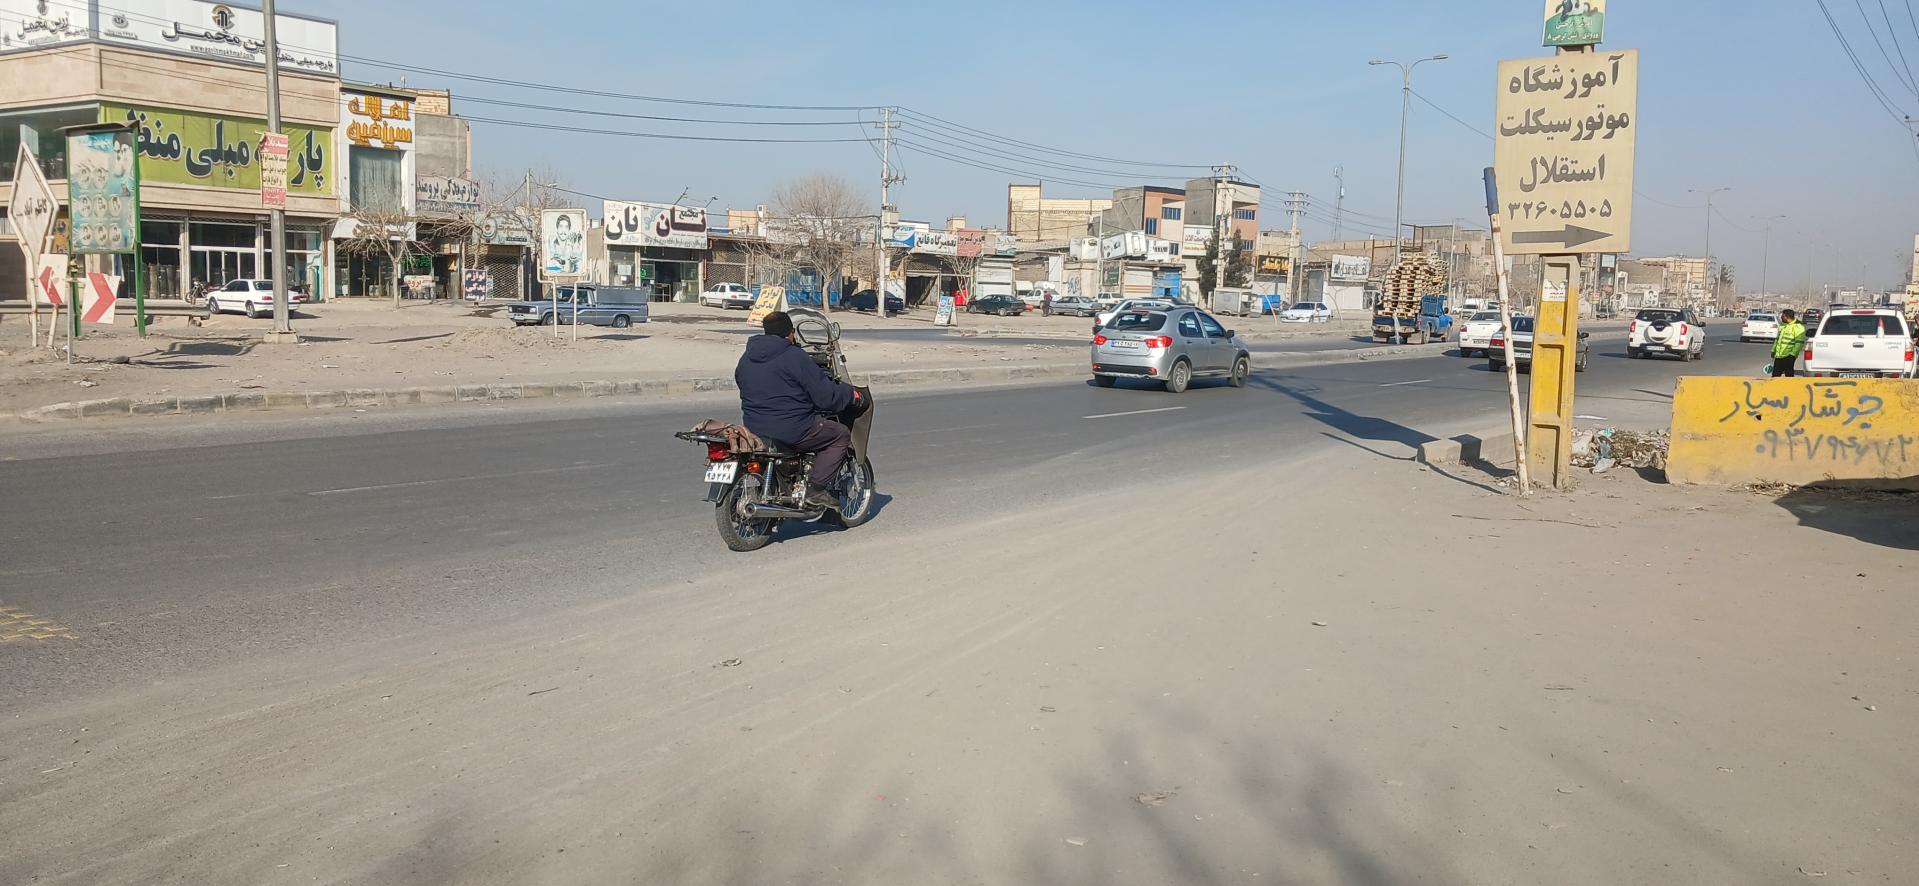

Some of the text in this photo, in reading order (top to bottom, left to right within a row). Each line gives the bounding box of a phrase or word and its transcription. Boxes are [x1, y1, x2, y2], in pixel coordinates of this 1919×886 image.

[1509, 54, 1625, 99] آموزشگاه
[185, 119, 251, 178] مبلی
[1519, 153, 1606, 193] استقلال
[606, 205, 640, 240] نان
[656, 206, 707, 237] نان
[1507, 198, 1613, 221] ۳۲۶۰۵۵۰۵
[465, 270, 486, 283] لوازم
[465, 282, 486, 294] یدکی
[1718, 380, 1790, 423] سیار
